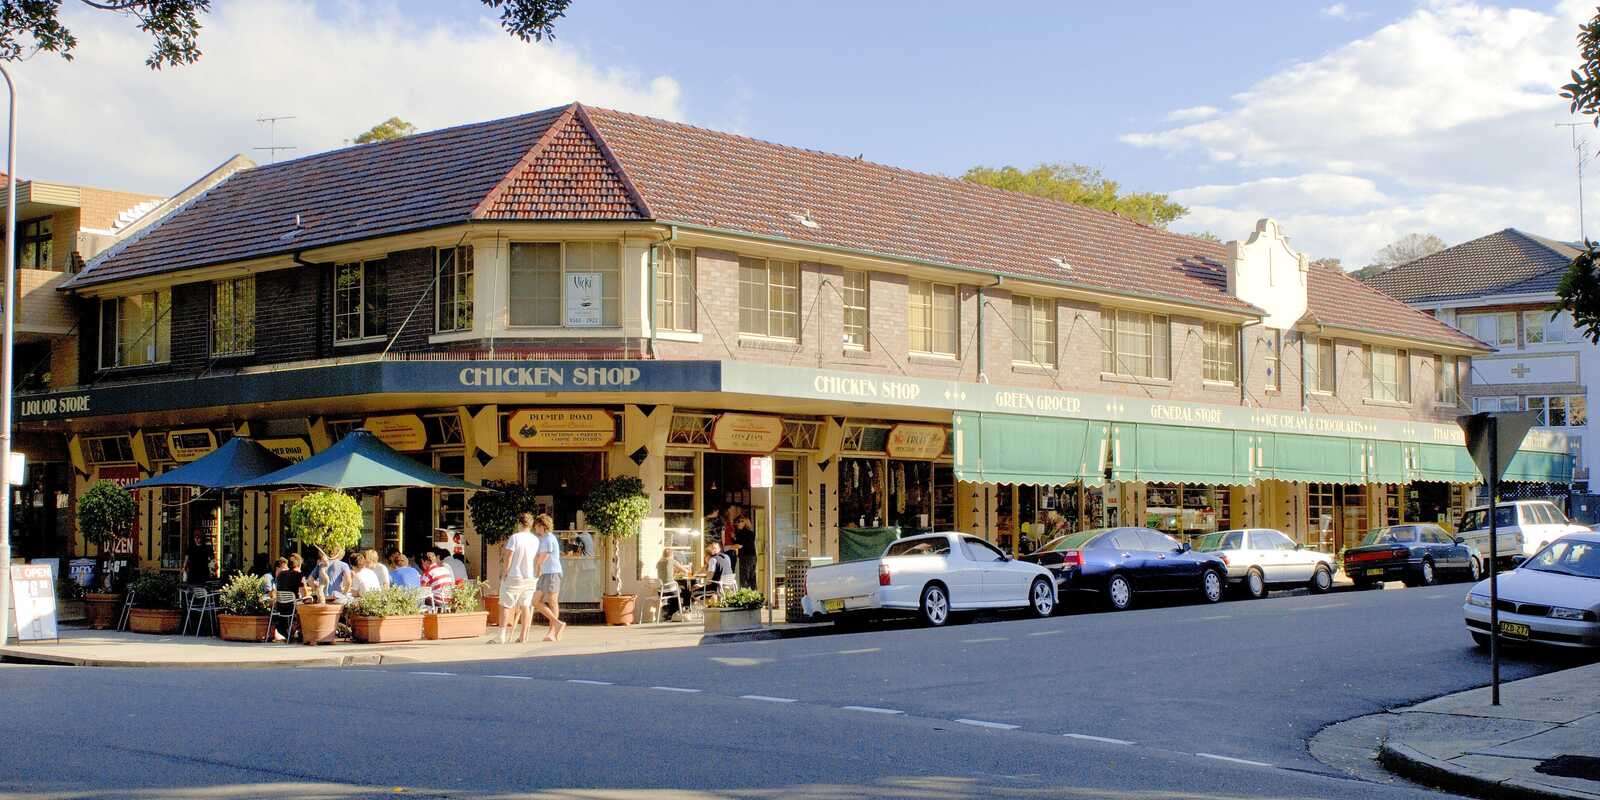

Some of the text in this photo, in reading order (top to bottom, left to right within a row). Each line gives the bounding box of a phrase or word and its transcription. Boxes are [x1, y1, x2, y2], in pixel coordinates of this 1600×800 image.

[459, 367, 641, 386] CHICKEN SHOP
[814, 375, 920, 400] CHICKEN SHOP
[21, 395, 91, 416] LIQUOR STORE
[995, 391, 1081, 413] GREEN GROCER
[569, 413, 593, 421] ROAD
[1151, 404, 1225, 424] GENERAL STORE
[1265, 414, 1278, 427] ICE
[1279, 415, 1308, 429] CREAM
[1315, 418, 1364, 433] CHOCOLATES
